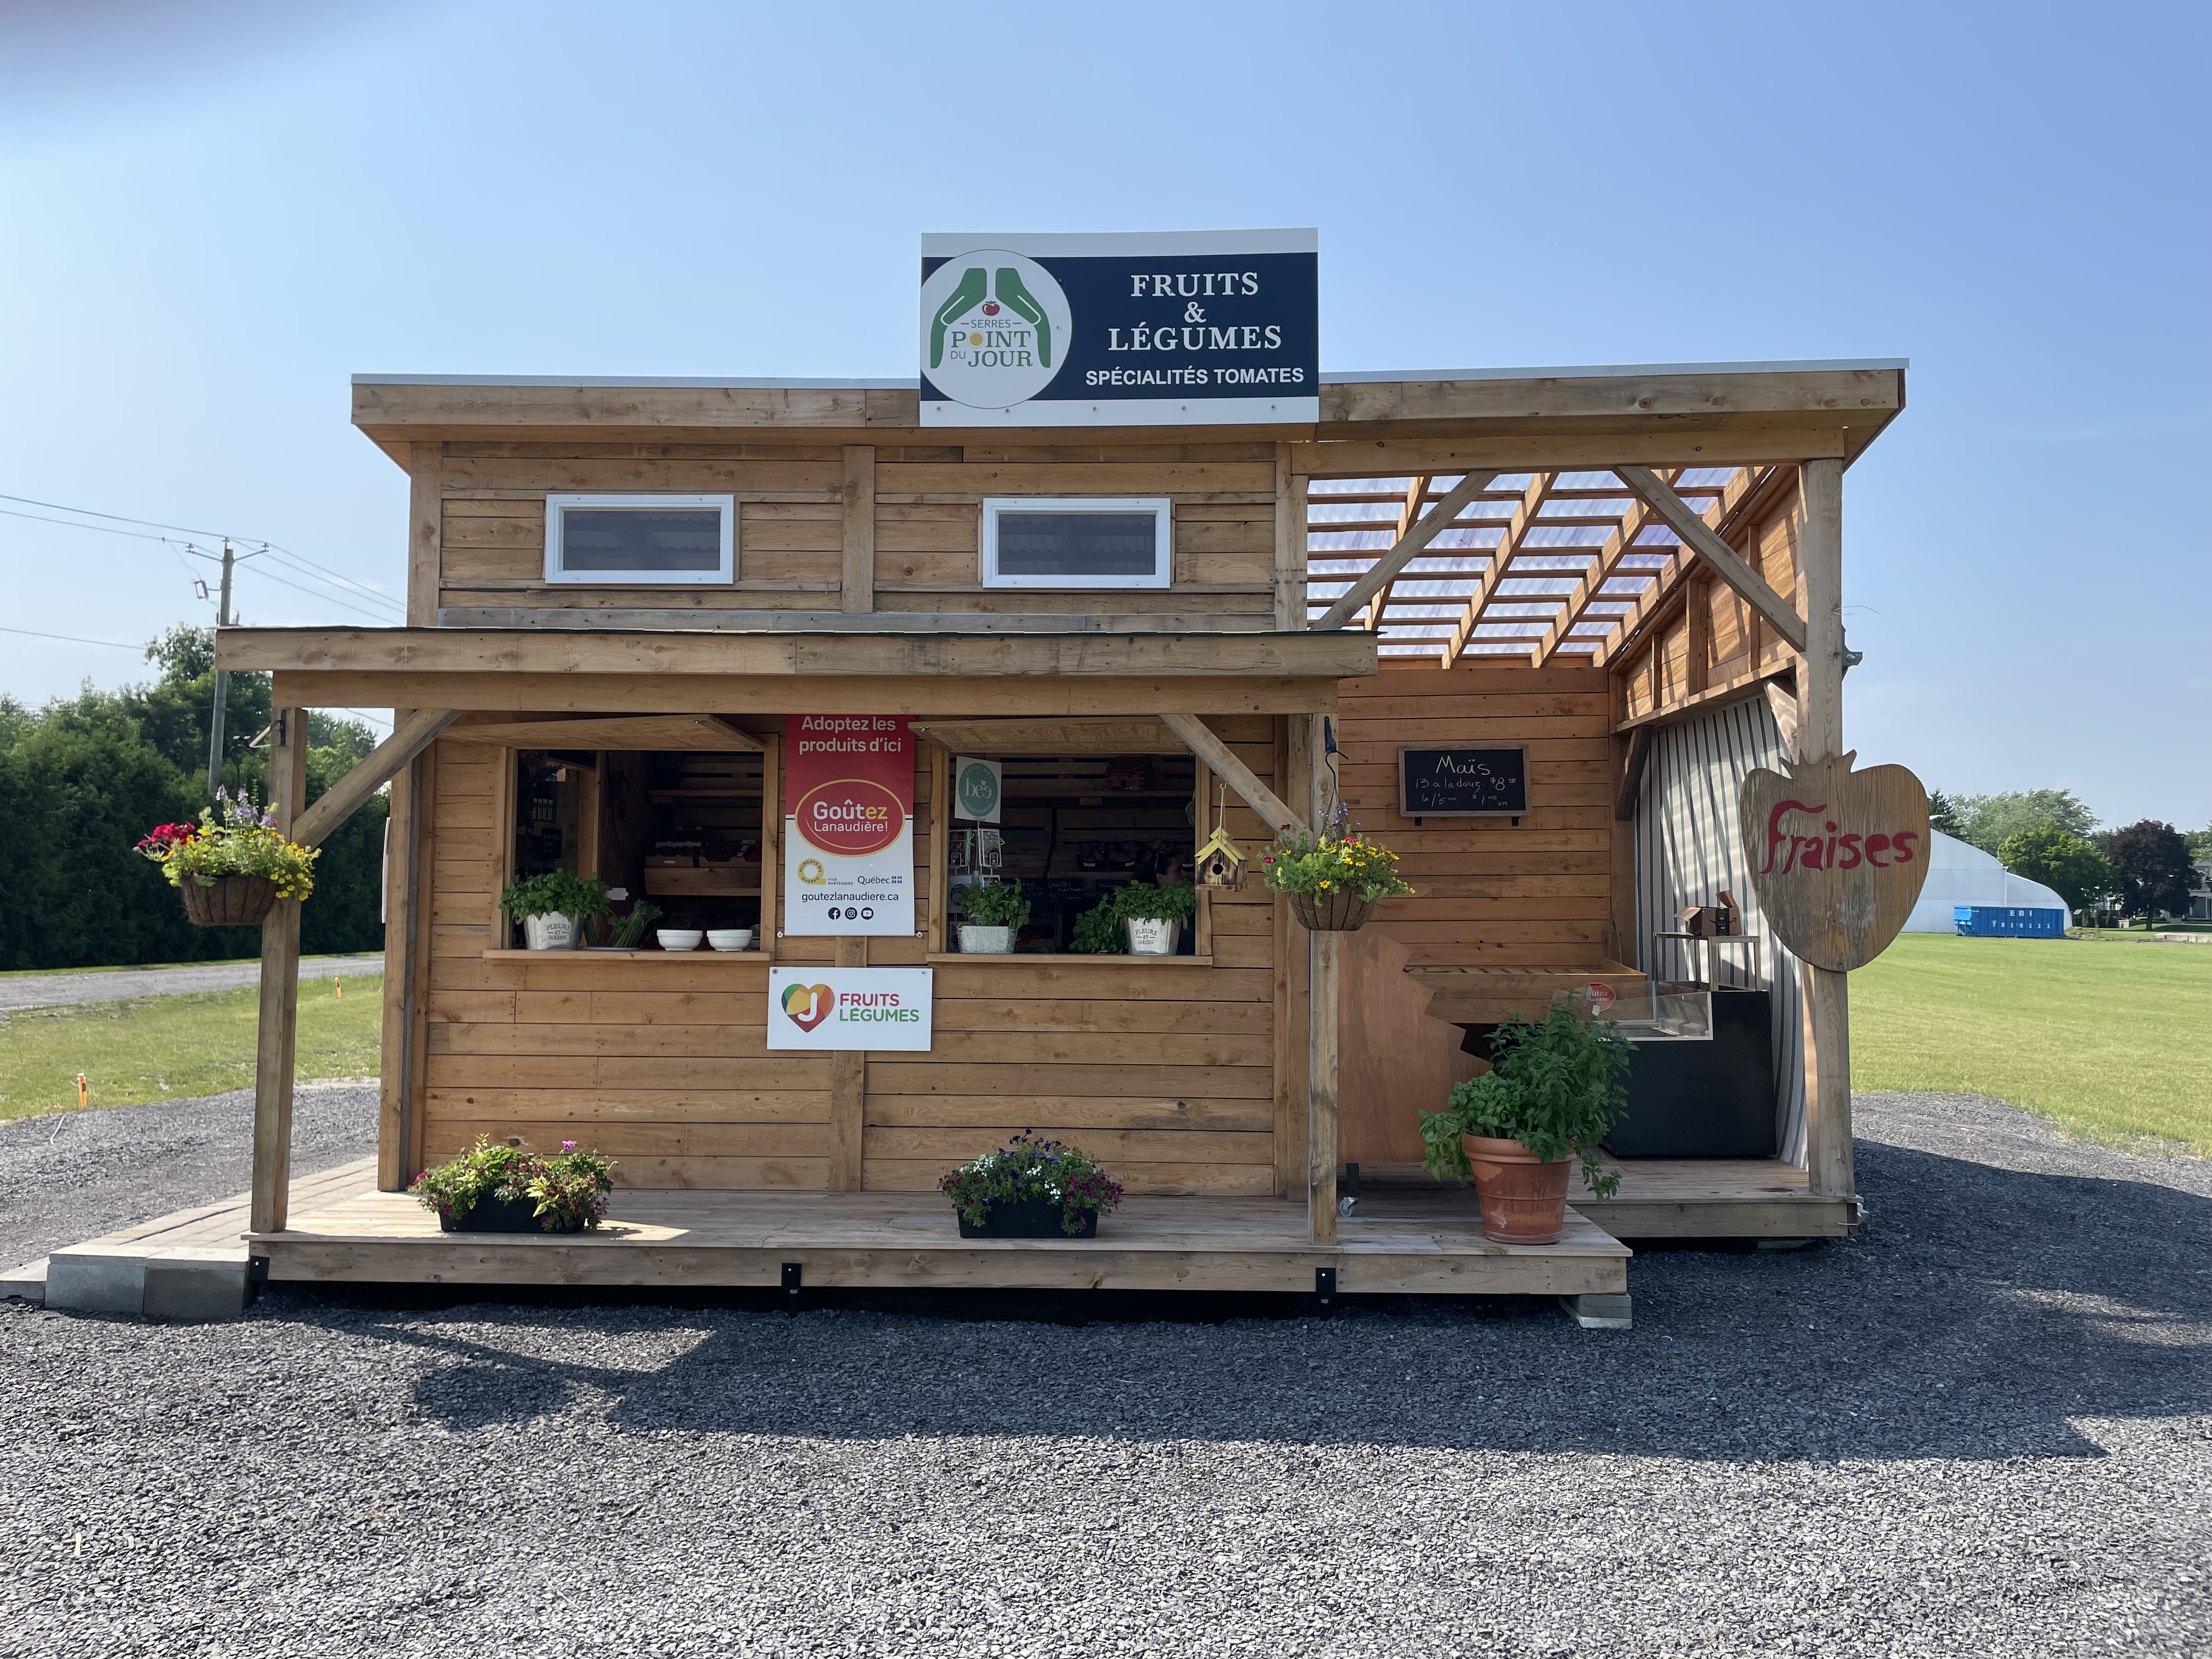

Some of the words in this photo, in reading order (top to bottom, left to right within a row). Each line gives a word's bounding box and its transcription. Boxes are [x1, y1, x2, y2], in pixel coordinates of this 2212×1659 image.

[1131, 272, 1259, 297] FRUITS
[1184, 301, 1206, 323] &
[971, 319, 1011, 328] SERRES
[951, 331, 1031, 348] POINT
[1108, 321, 1281, 351] LÉGUMES
[950, 351, 966, 359] DU
[968, 351, 1033, 367] JOUR
[1086, 365, 1208, 385] SPÉCIALITÉS
[1213, 367, 1304, 383] TOMATES
[802, 716, 869, 733] Adoptez
[873, 716, 896, 731] les
[799, 737, 866, 755] produits
[870, 737, 901, 752] d'ici
[1436, 755, 1491, 775] Maïs
[965, 777, 992, 799] bee
[1415, 778, 1430, 788] 13
[1444, 777, 1454, 788] la
[814, 799, 888, 820] Goûtez
[814, 821, 888, 832] Lanaudière!
[857, 876, 890, 885] Québec
[802, 892, 899, 902] goutezlanaudiere.ca
[839, 993, 900, 1007] FRUITS
[839, 1007, 919, 1022] LÉGUMES
